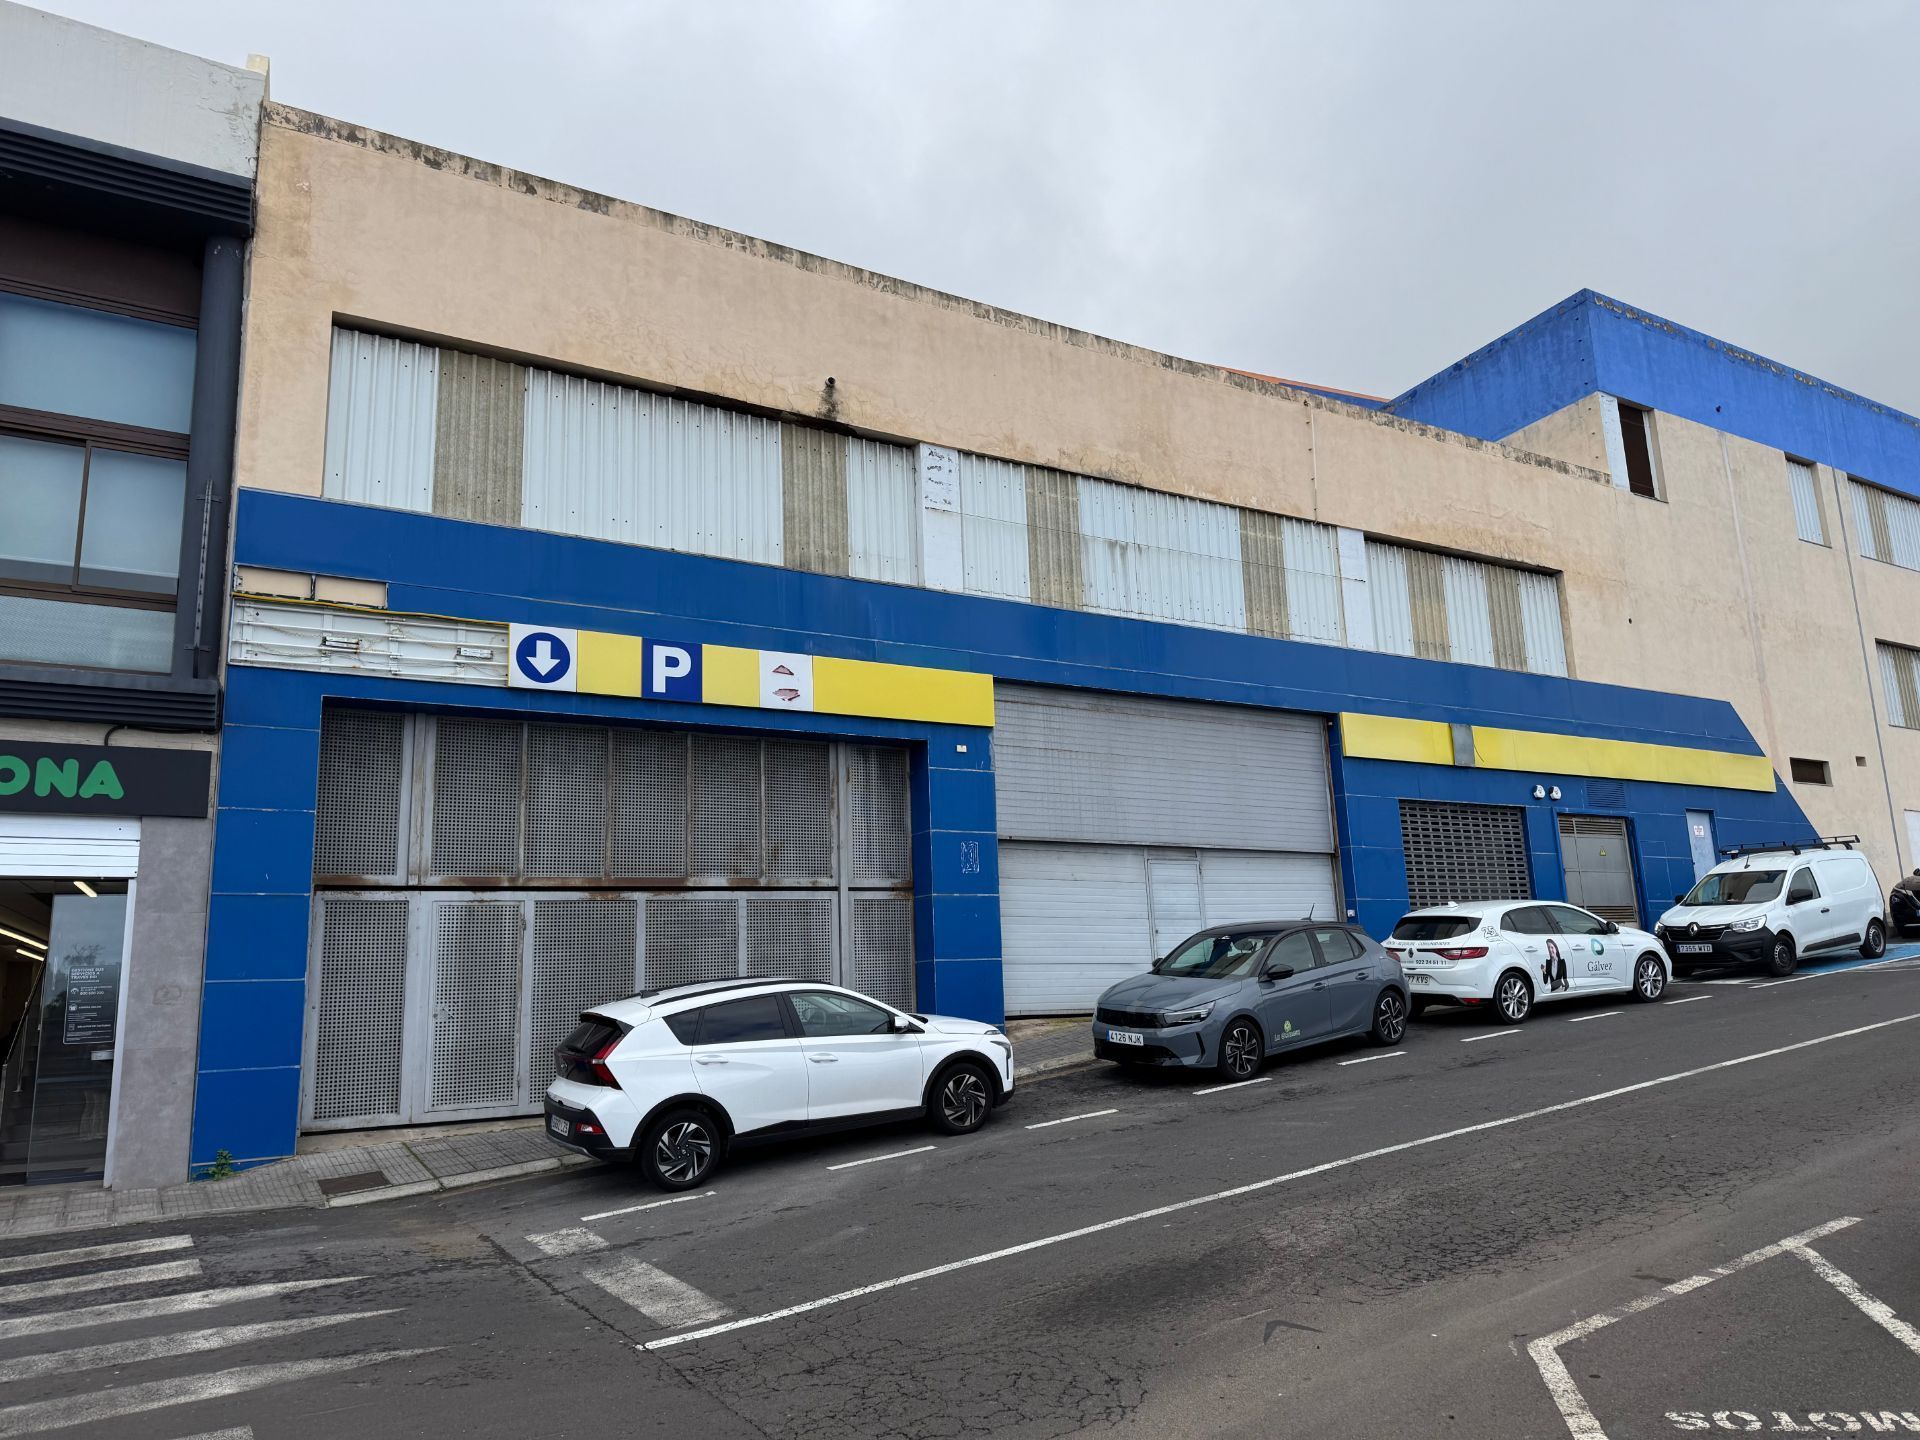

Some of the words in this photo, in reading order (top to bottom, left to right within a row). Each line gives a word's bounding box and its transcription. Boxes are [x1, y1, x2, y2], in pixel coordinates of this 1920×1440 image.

[653, 645, 692, 693] P
[0, 755, 125, 800] ONA
[1587, 960, 1613, 971] Gálvez
[1415, 975, 1429, 984] KVS
[1110, 1031, 1127, 1043] 4126
[1664, 1411, 1920, 1432] MOTOS
